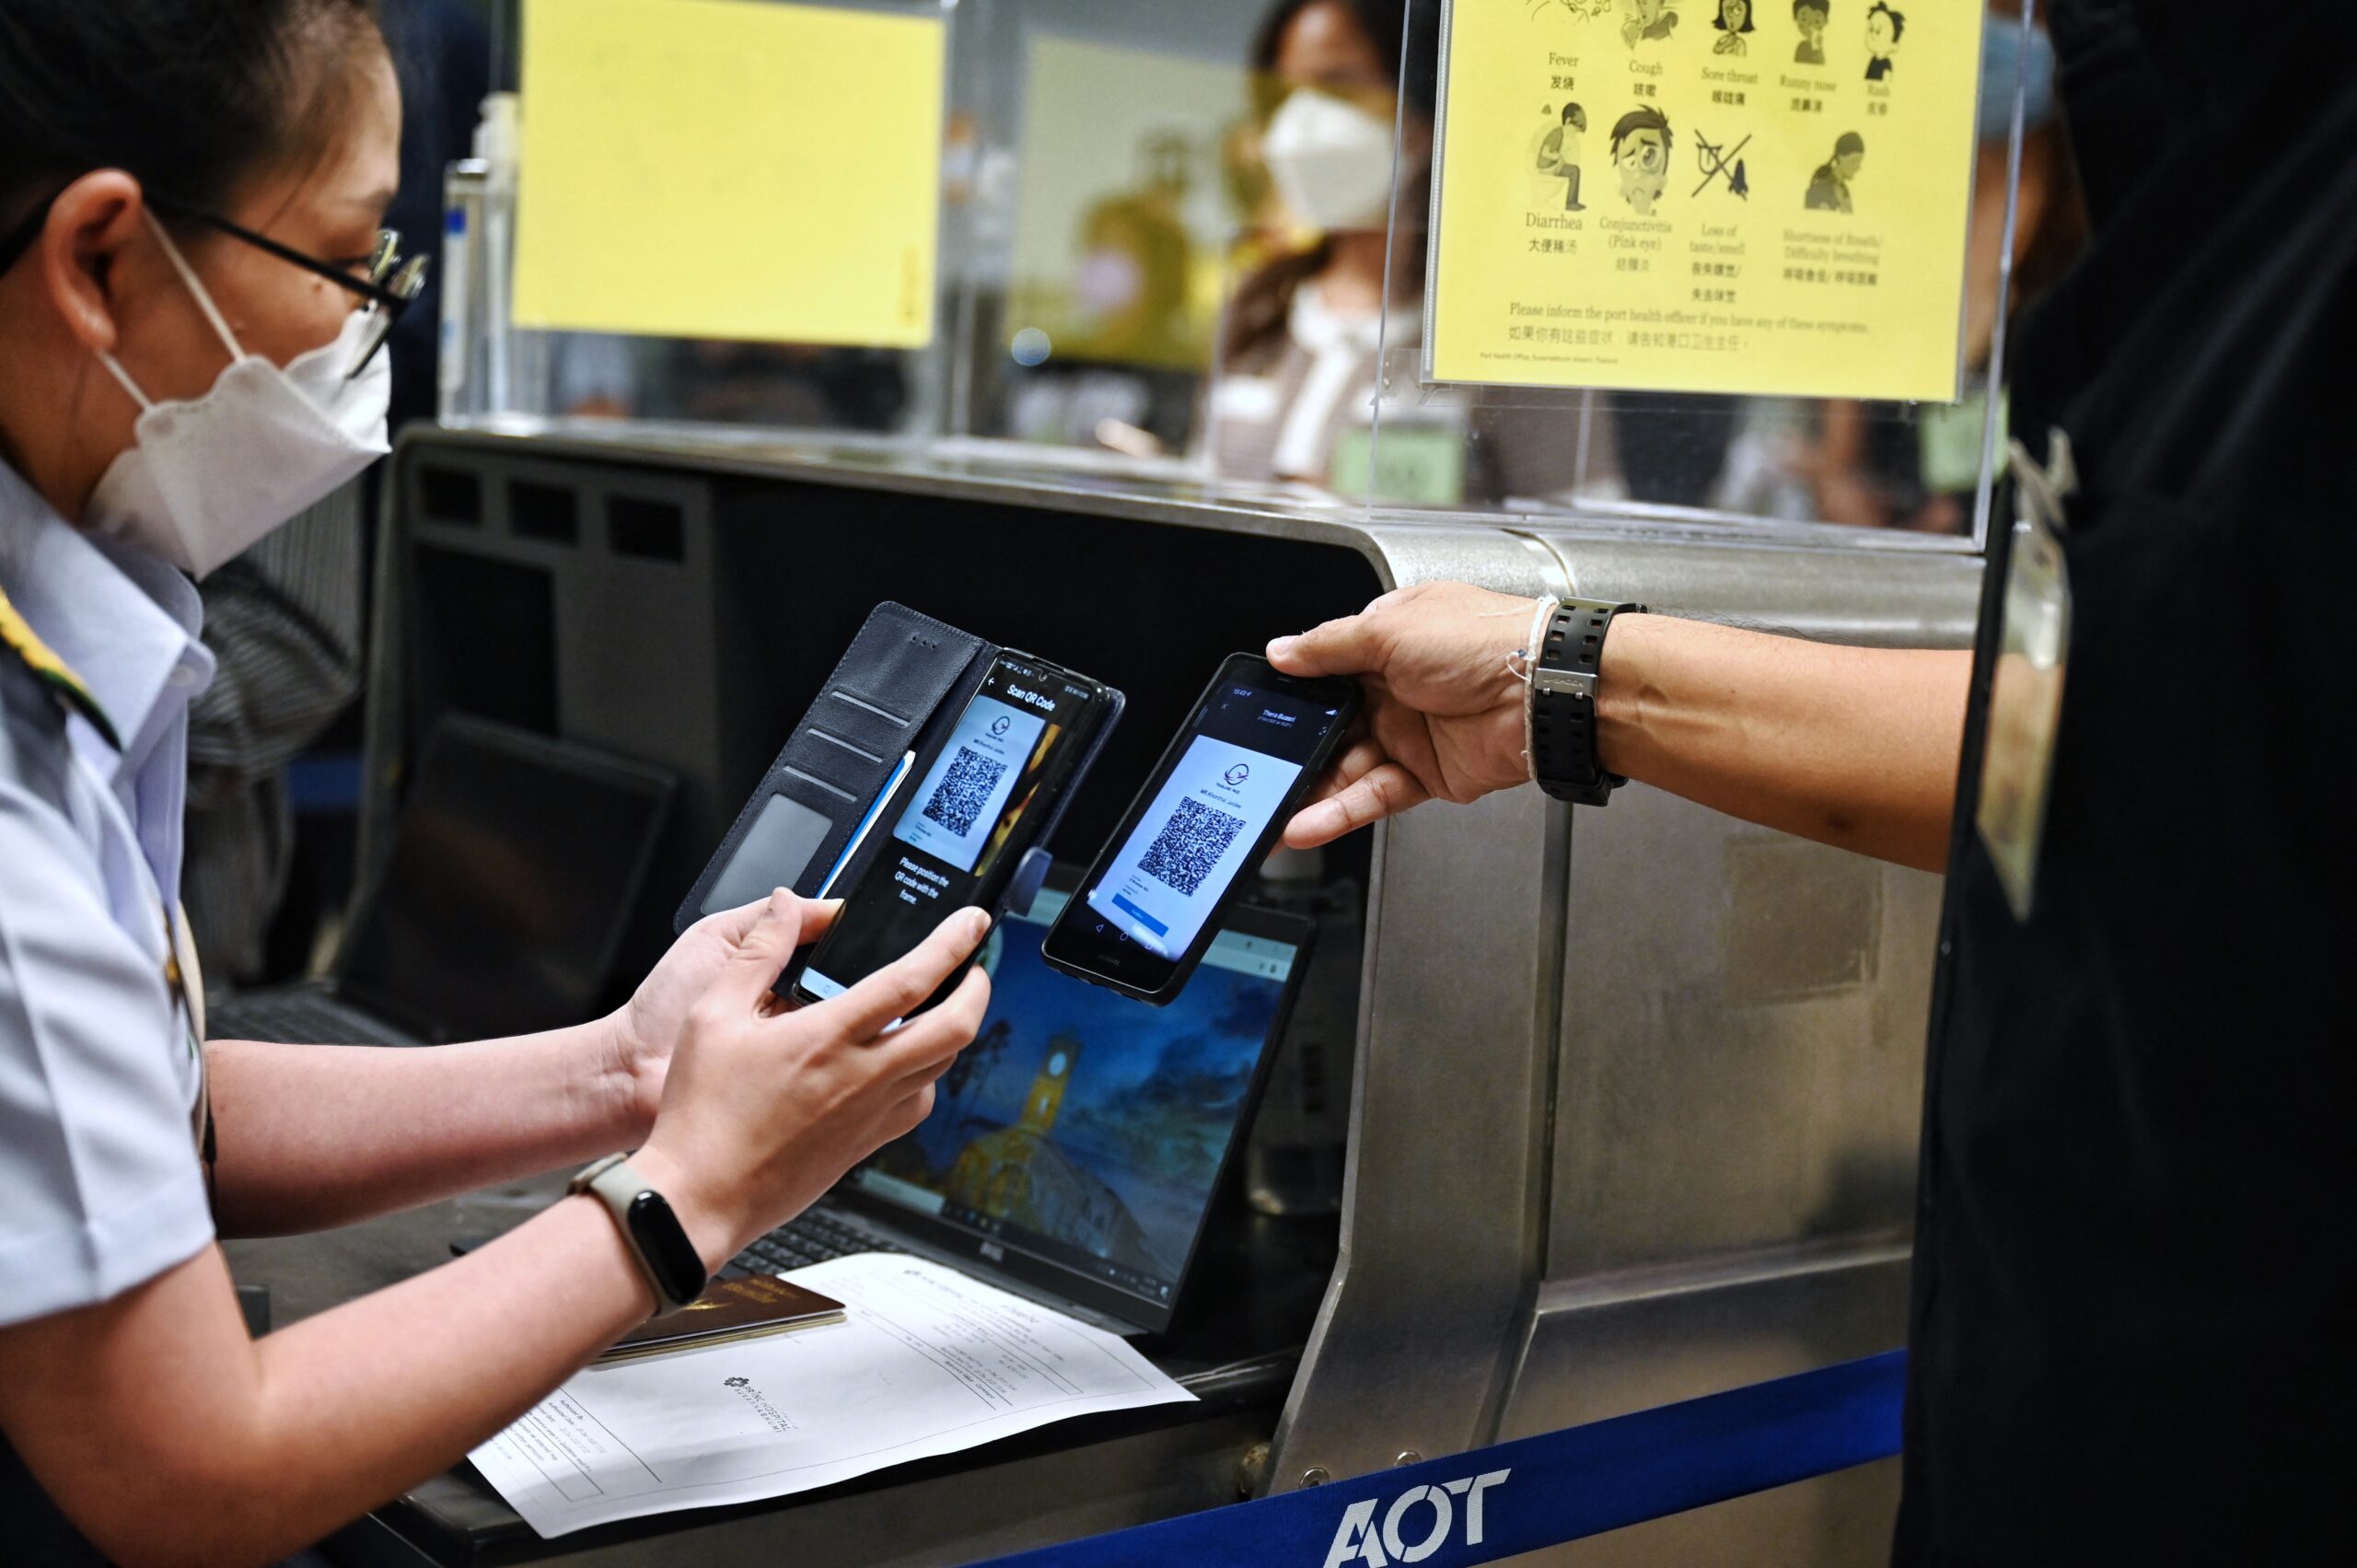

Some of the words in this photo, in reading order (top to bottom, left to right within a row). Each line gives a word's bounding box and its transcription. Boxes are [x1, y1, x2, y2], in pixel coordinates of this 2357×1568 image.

[1549, 52, 1579, 67] Fever
[1629, 60, 1663, 76] Cough
[1701, 67, 1724, 81] Sore
[1727, 69, 1758, 85] throat
[1780, 75, 1811, 92] Runny
[1814, 80, 1837, 92] nose
[1526, 212, 1583, 230] Diarrhea
[1599, 216, 1673, 233] Conjunctivitis
[1701, 224, 1724, 237] Loss
[1725, 225, 1738, 237] of
[1608, 234, 1636, 250] (Pink
[1639, 238, 1662, 253] eye)
[1510, 302, 1544, 318] Please
[1546, 304, 1583, 319] inform
[1585, 306, 1603, 320] the
[1604, 308, 1627, 323] port
[1629, 308, 1663, 323] health
[1664, 309, 1697, 324] officer
[1006, 684, 1027, 700] Scan
[1024, 691, 1039, 704] QR
[1036, 697, 1056, 712] Code
[900, 856, 920, 873] Please
[916, 866, 940, 884] position
[937, 876, 949, 888] the
[894, 870, 906, 881] QR
[902, 877, 918, 889] code
[916, 882, 930, 894] with
[927, 888, 939, 900] the
[760, 1402, 792, 1432] HOSPITAL
[1323, 1468, 1512, 1568] AOT
